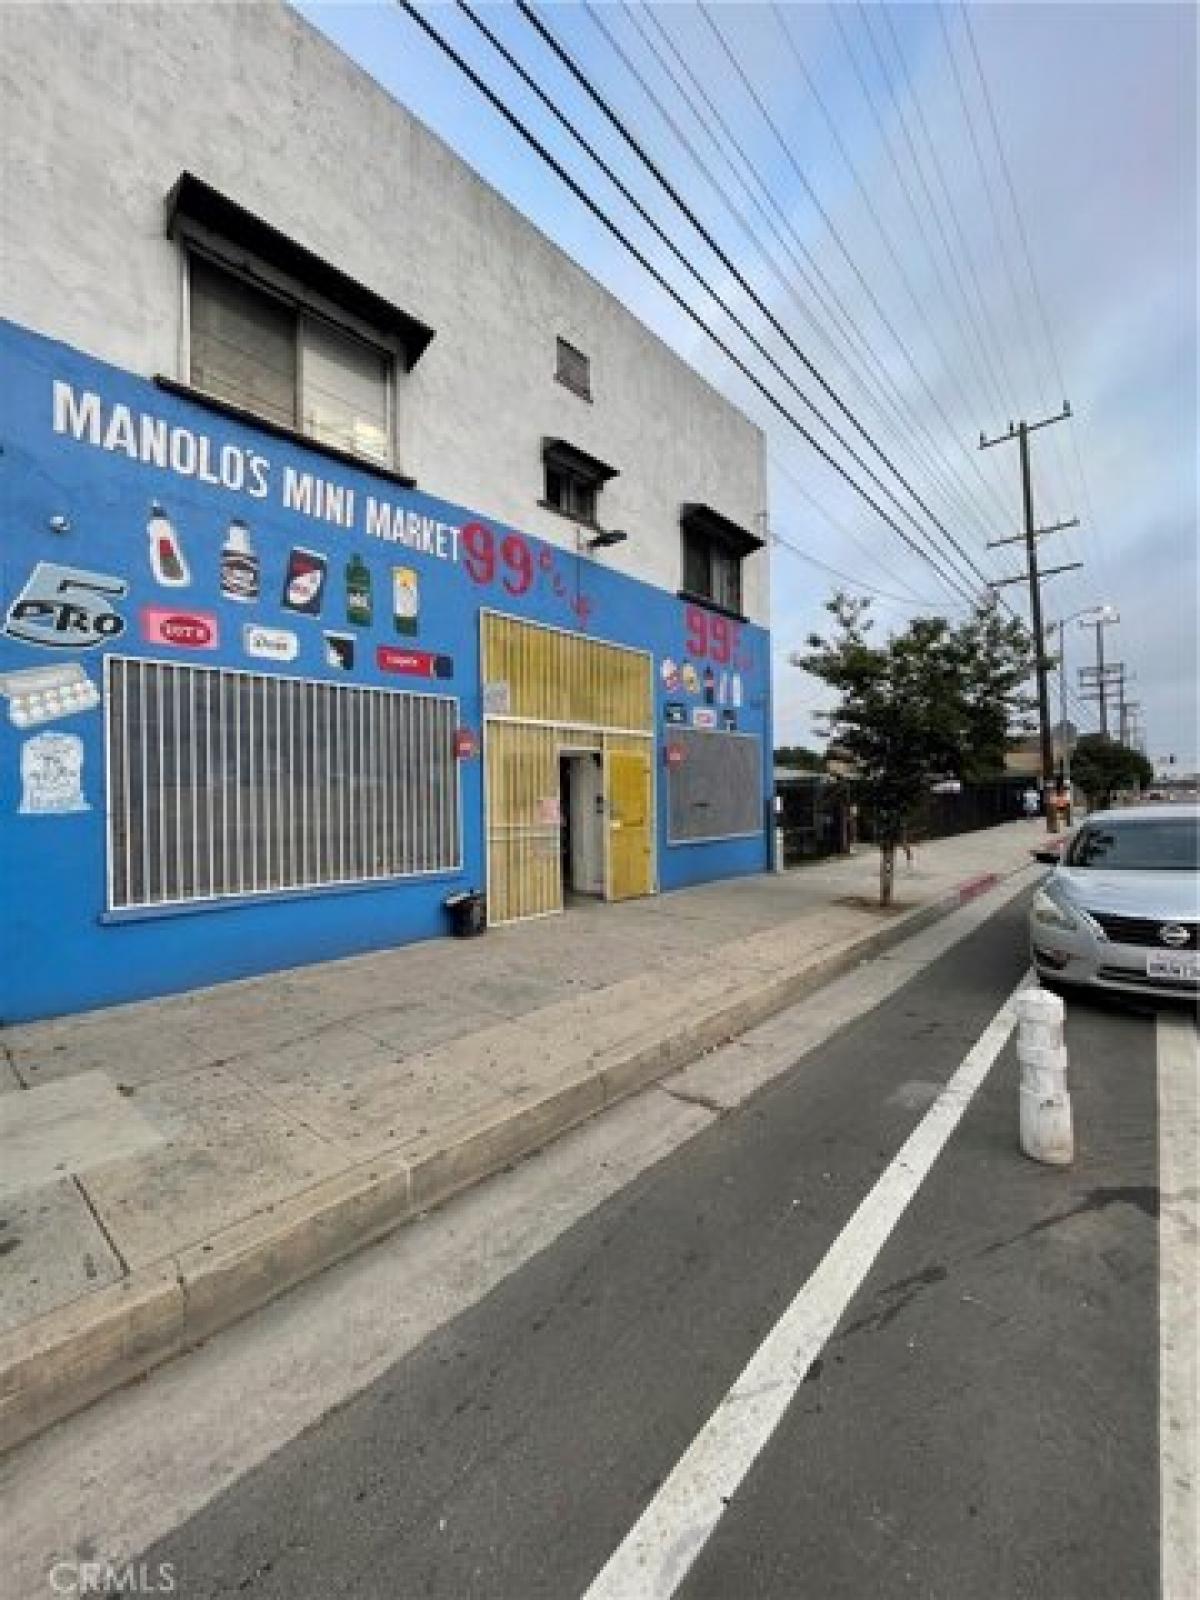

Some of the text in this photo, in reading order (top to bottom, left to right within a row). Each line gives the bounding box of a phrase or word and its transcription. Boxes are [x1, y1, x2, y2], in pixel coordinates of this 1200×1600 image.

[53, 380, 461, 562] MANOLO'S MINI MARKET
